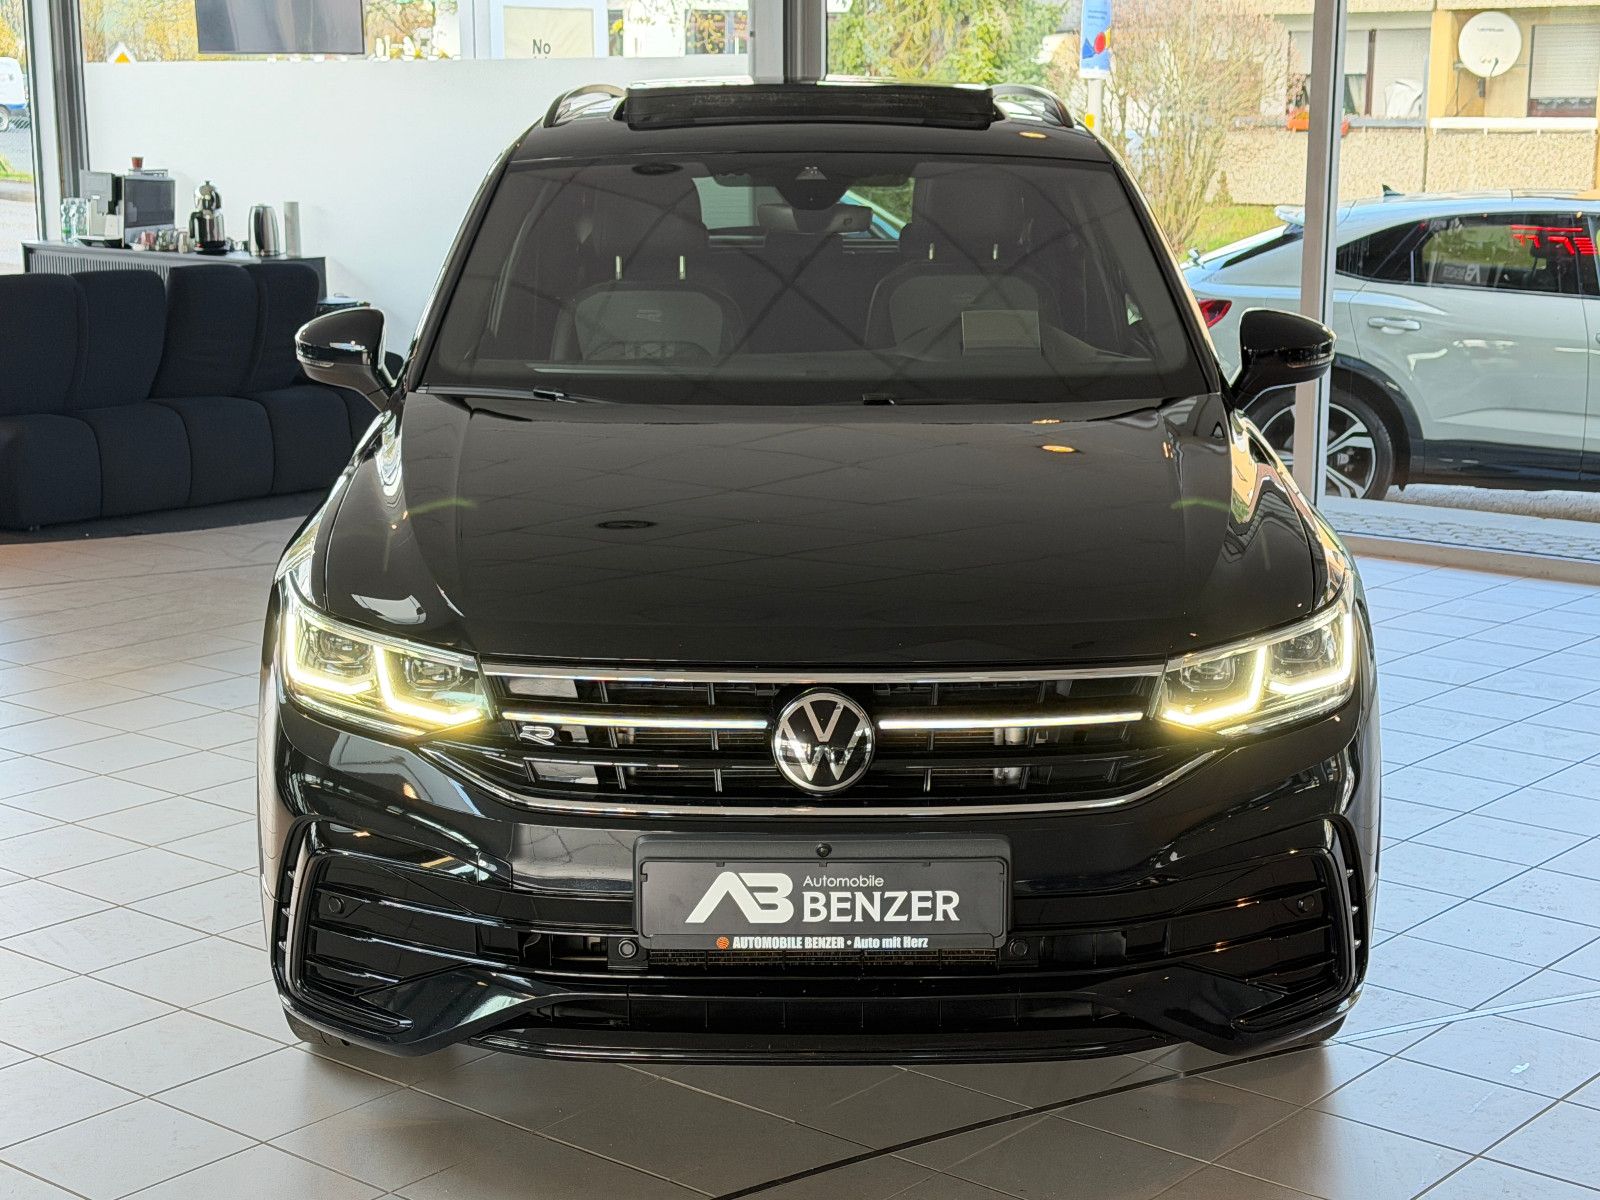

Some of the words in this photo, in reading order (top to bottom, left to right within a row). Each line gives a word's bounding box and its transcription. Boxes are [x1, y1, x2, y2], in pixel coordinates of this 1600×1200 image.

[532, 38, 551, 55] No
[802, 874, 885, 888] Automobile
[685, 871, 795, 924] AB
[802, 890, 960, 923] BENZER
[733, 936, 802, 949] AUTOMOBILE
[804, 936, 845, 949] BENZER
[853, 936, 880, 949] Auto
[882, 936, 901, 949] mit
[903, 936, 929, 949] Herz
